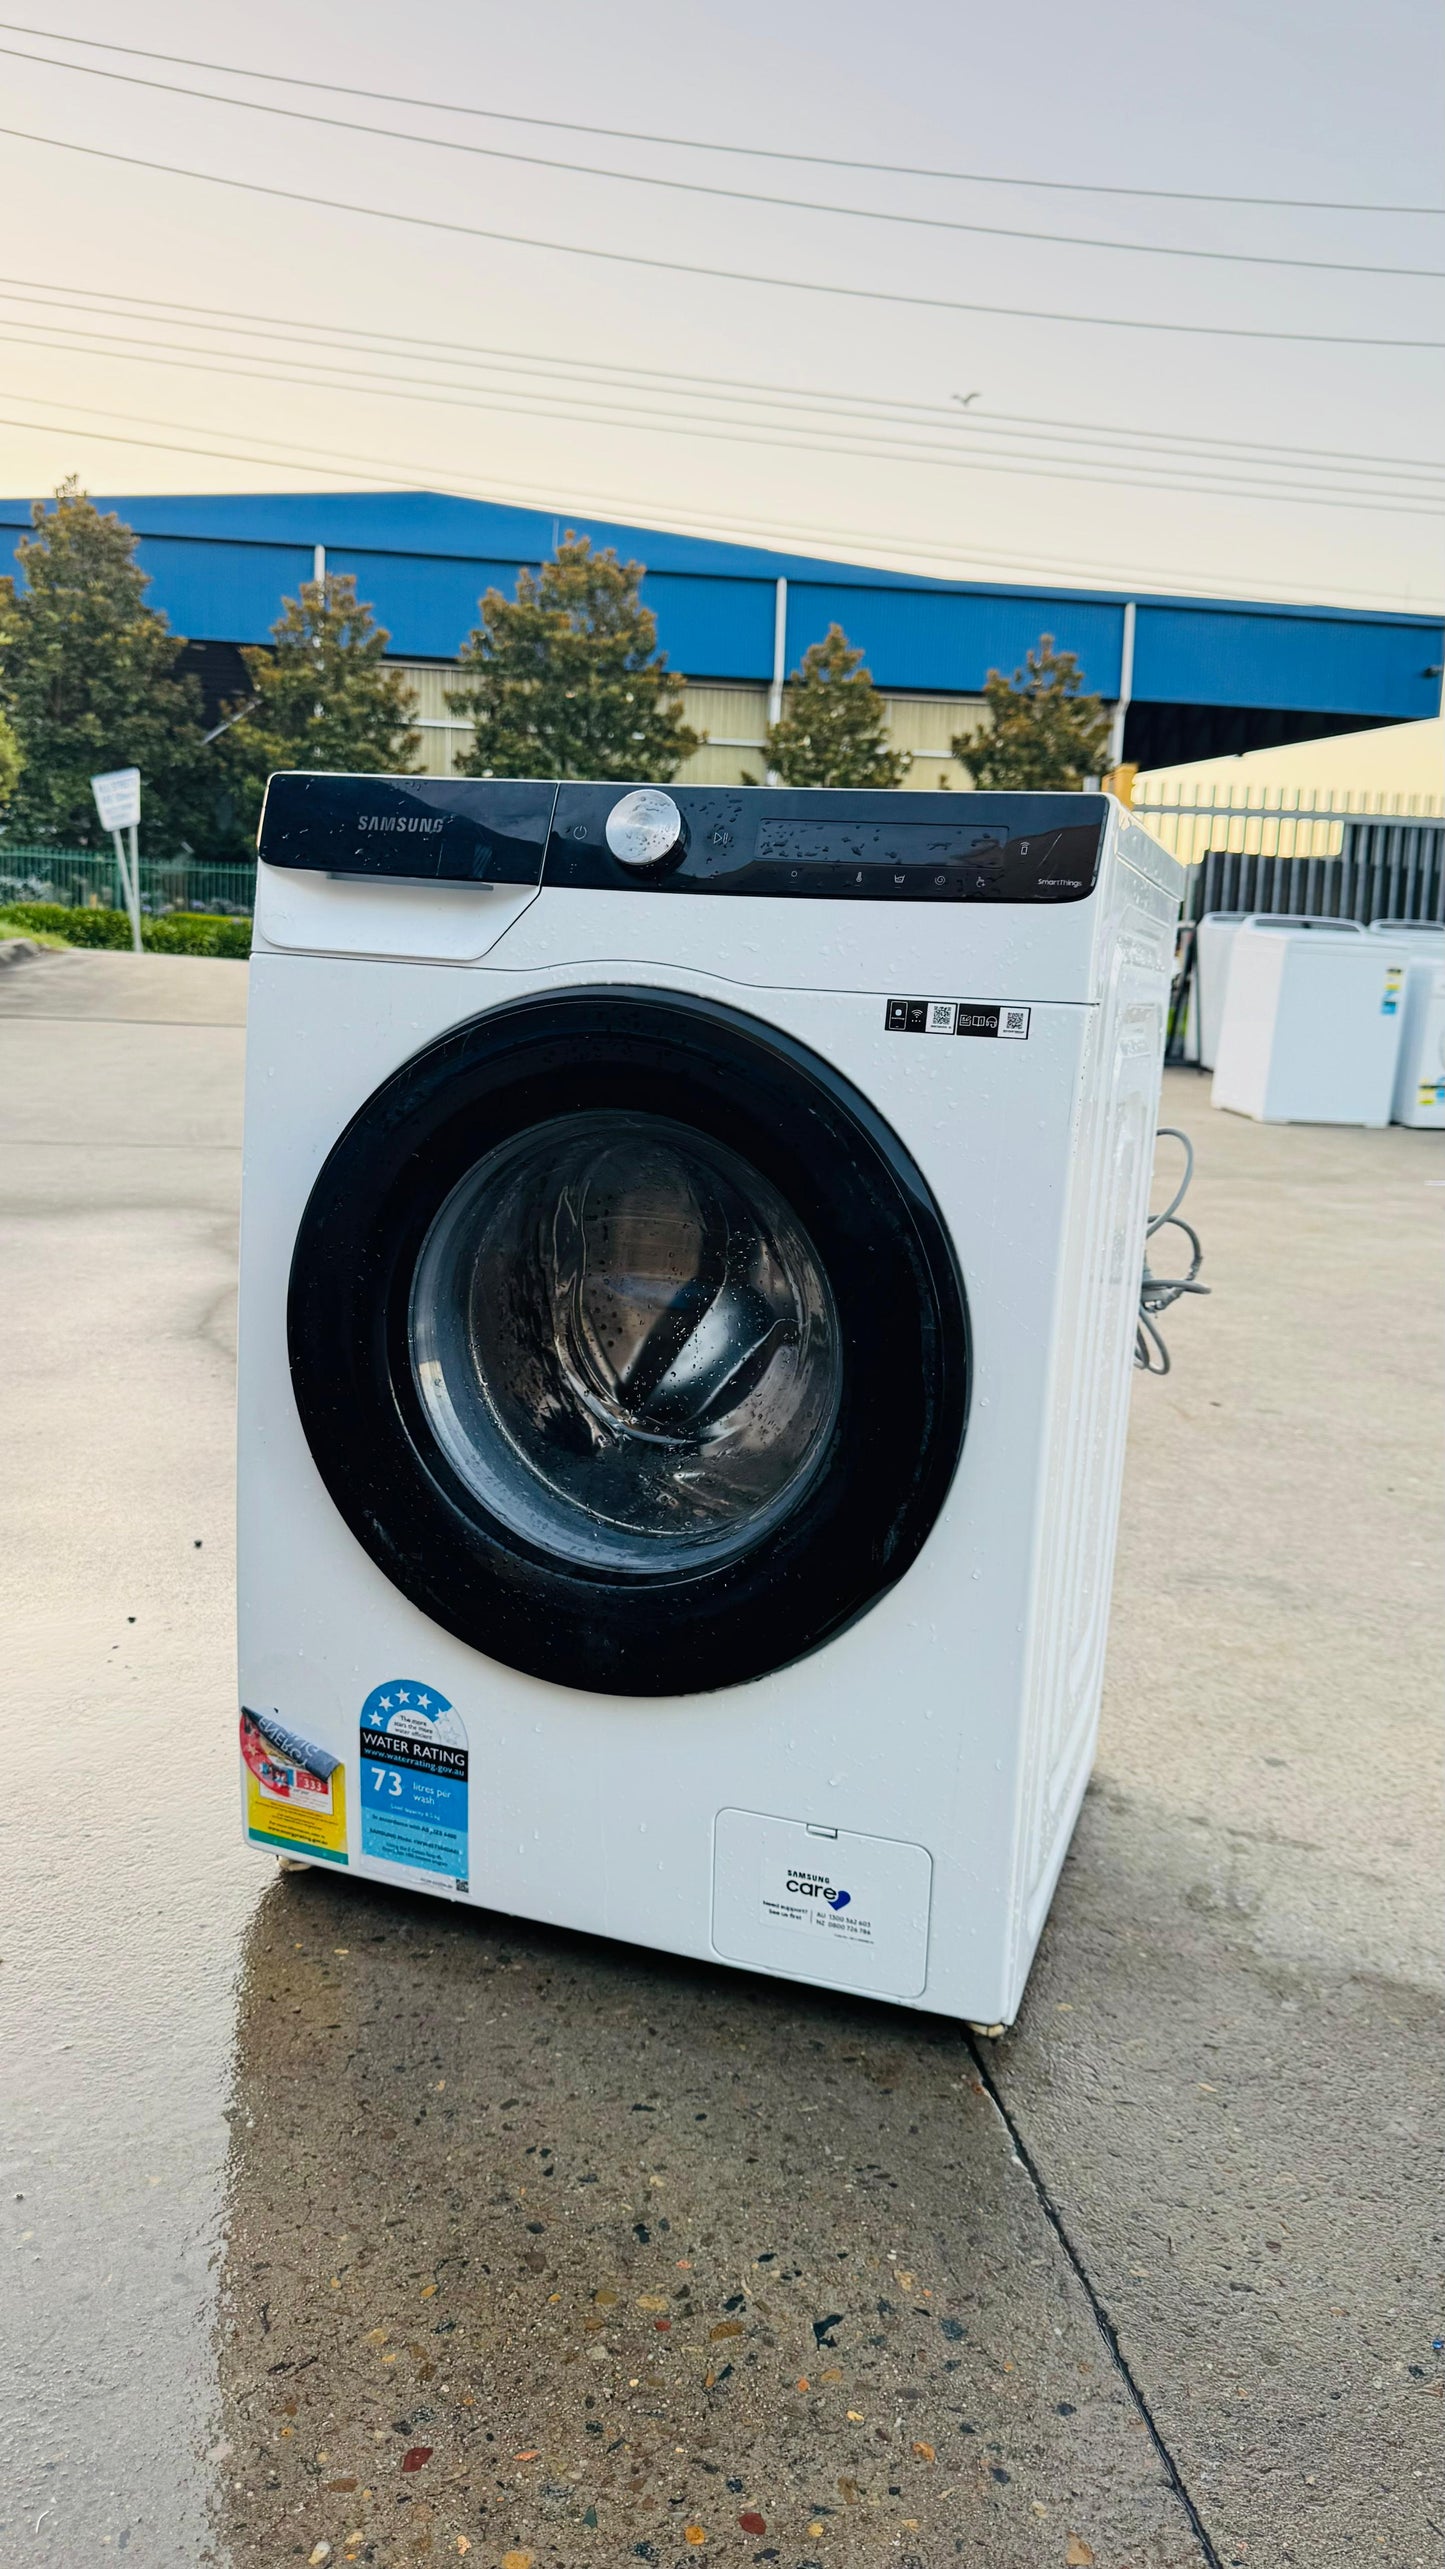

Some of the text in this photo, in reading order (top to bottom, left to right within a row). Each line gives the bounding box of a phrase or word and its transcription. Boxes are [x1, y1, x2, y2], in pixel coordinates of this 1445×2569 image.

[358, 815, 444, 833] SAMSUNG
[1038, 878, 1083, 888] SmartThings
[363, 1732, 466, 1766] WATER RATING
[364, 1747, 465, 1776] www.waterrating.gov.au
[303, 1778, 322, 1792] 333
[371, 1767, 403, 1796] 73
[413, 1781, 452, 1798] litres per
[413, 1794, 435, 1805] wash
[787, 1870, 830, 1884] SAMSUNG
[786, 1880, 837, 1900] care
